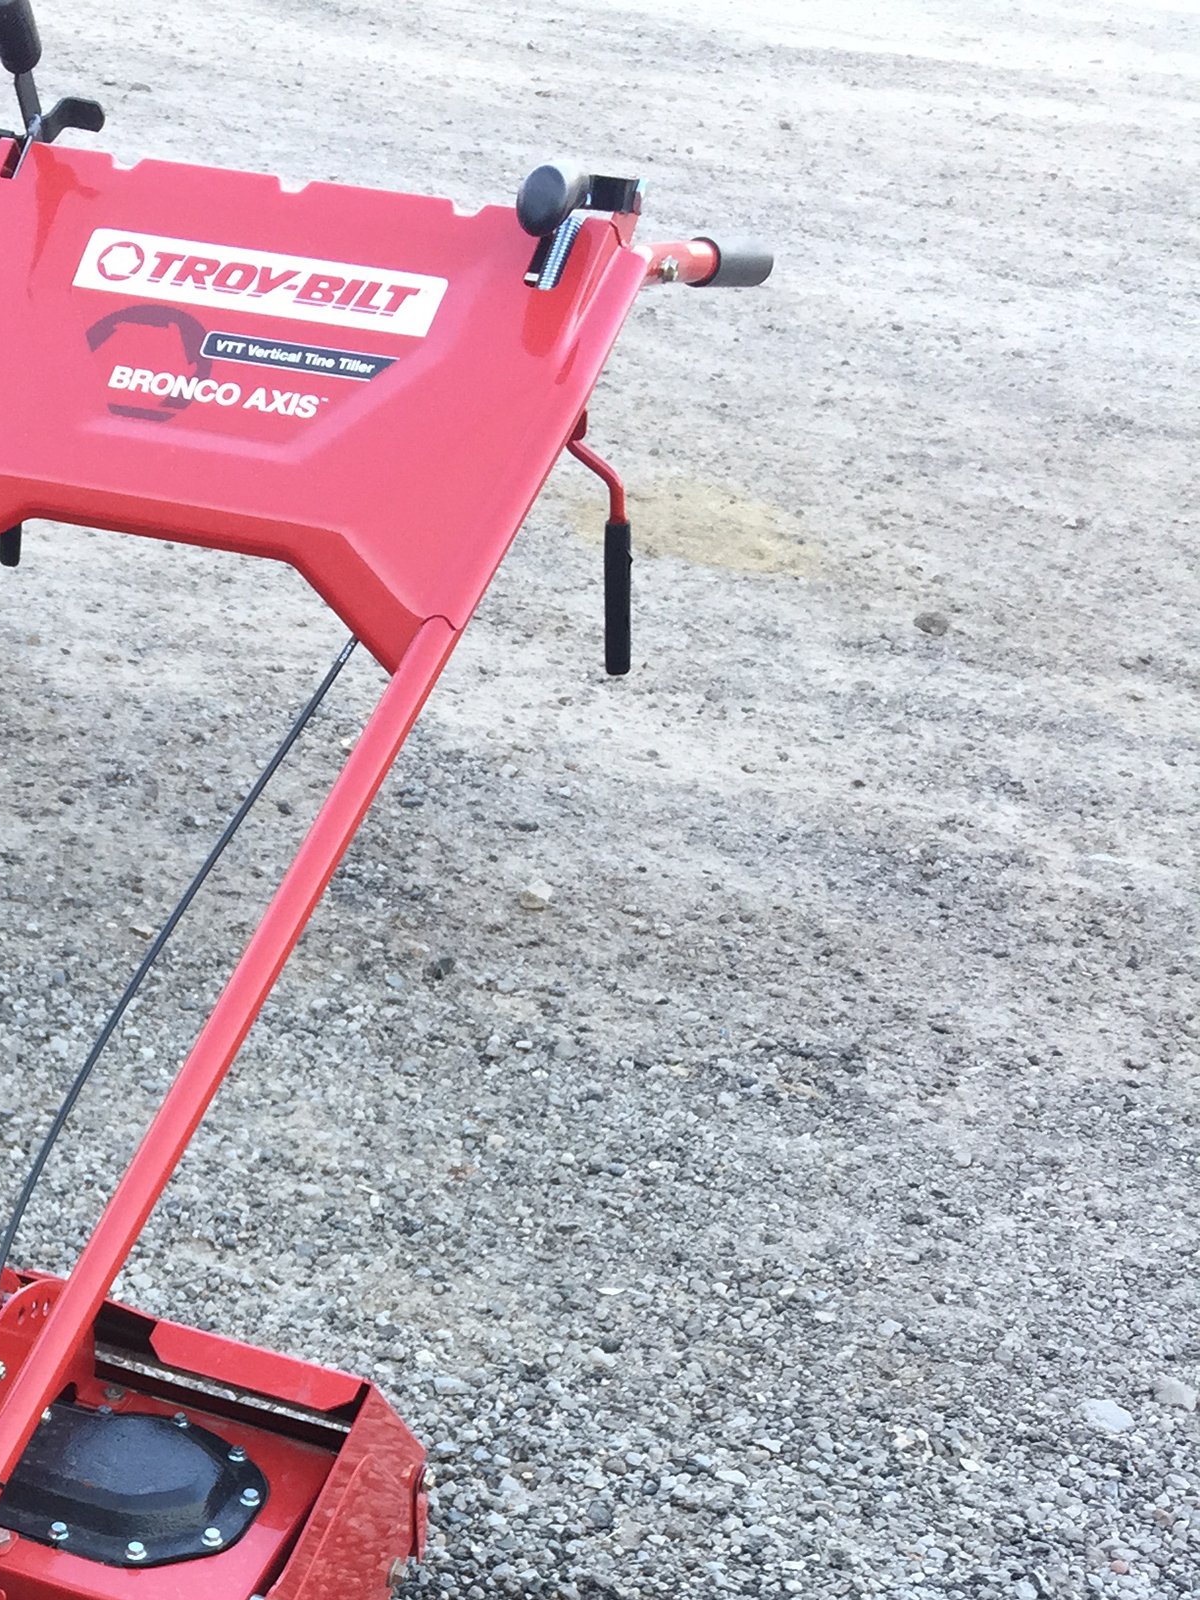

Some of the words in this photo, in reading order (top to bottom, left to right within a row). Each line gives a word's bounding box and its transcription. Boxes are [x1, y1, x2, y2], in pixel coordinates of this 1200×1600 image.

[147, 251, 421, 317] TROY-BILT
[216, 339, 246, 355] VTT
[248, 343, 301, 364] Vertical
[305, 352, 335, 370] Tine
[338, 357, 376, 375] Tiller
[108, 365, 242, 407] BRONCO
[242, 387, 320, 418] AXIS
